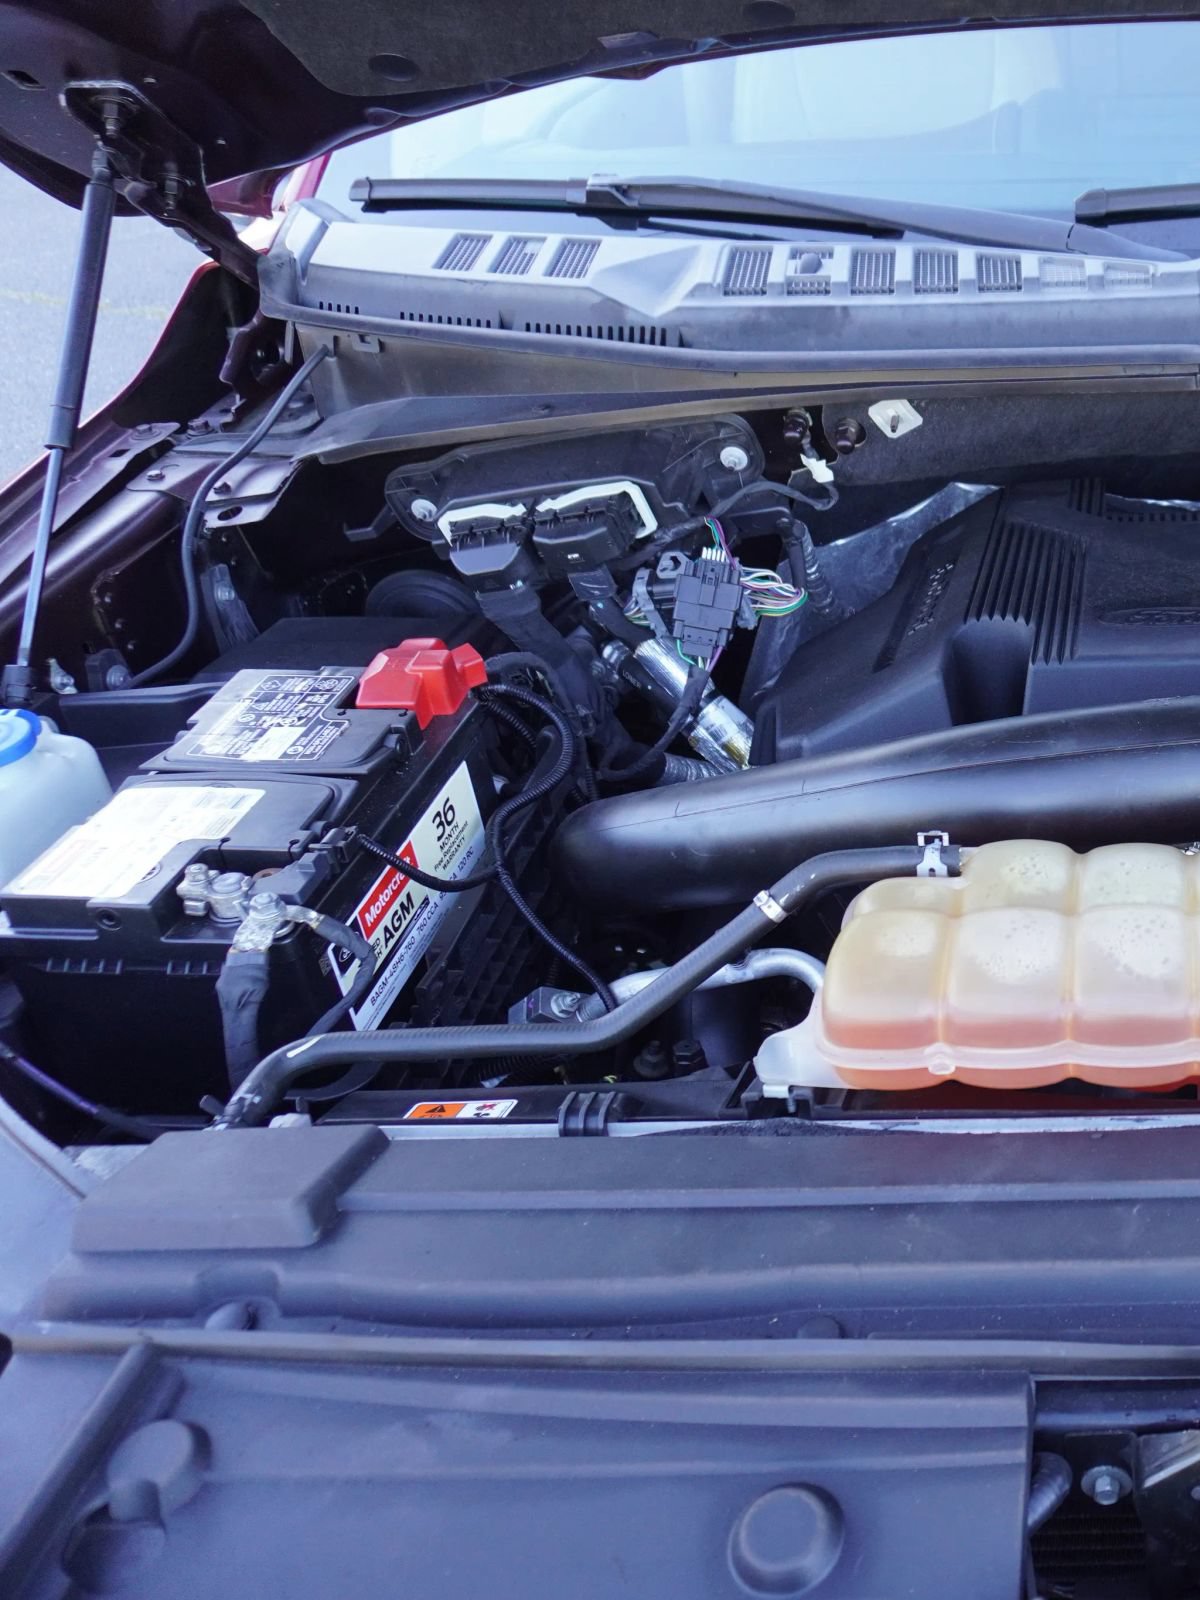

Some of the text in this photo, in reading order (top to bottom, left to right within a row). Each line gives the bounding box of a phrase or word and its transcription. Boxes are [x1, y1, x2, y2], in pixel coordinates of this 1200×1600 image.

[432, 797, 455, 842] 36
[440, 821, 459, 852] MONTH
[442, 834, 465, 870] WARRANTY
[443, 820, 468, 858] Replacement
[364, 856, 411, 927] Motorcrat
[383, 891, 414, 949] AGM
[416, 917, 428, 936] 760
[426, 902, 439, 921] CCA
